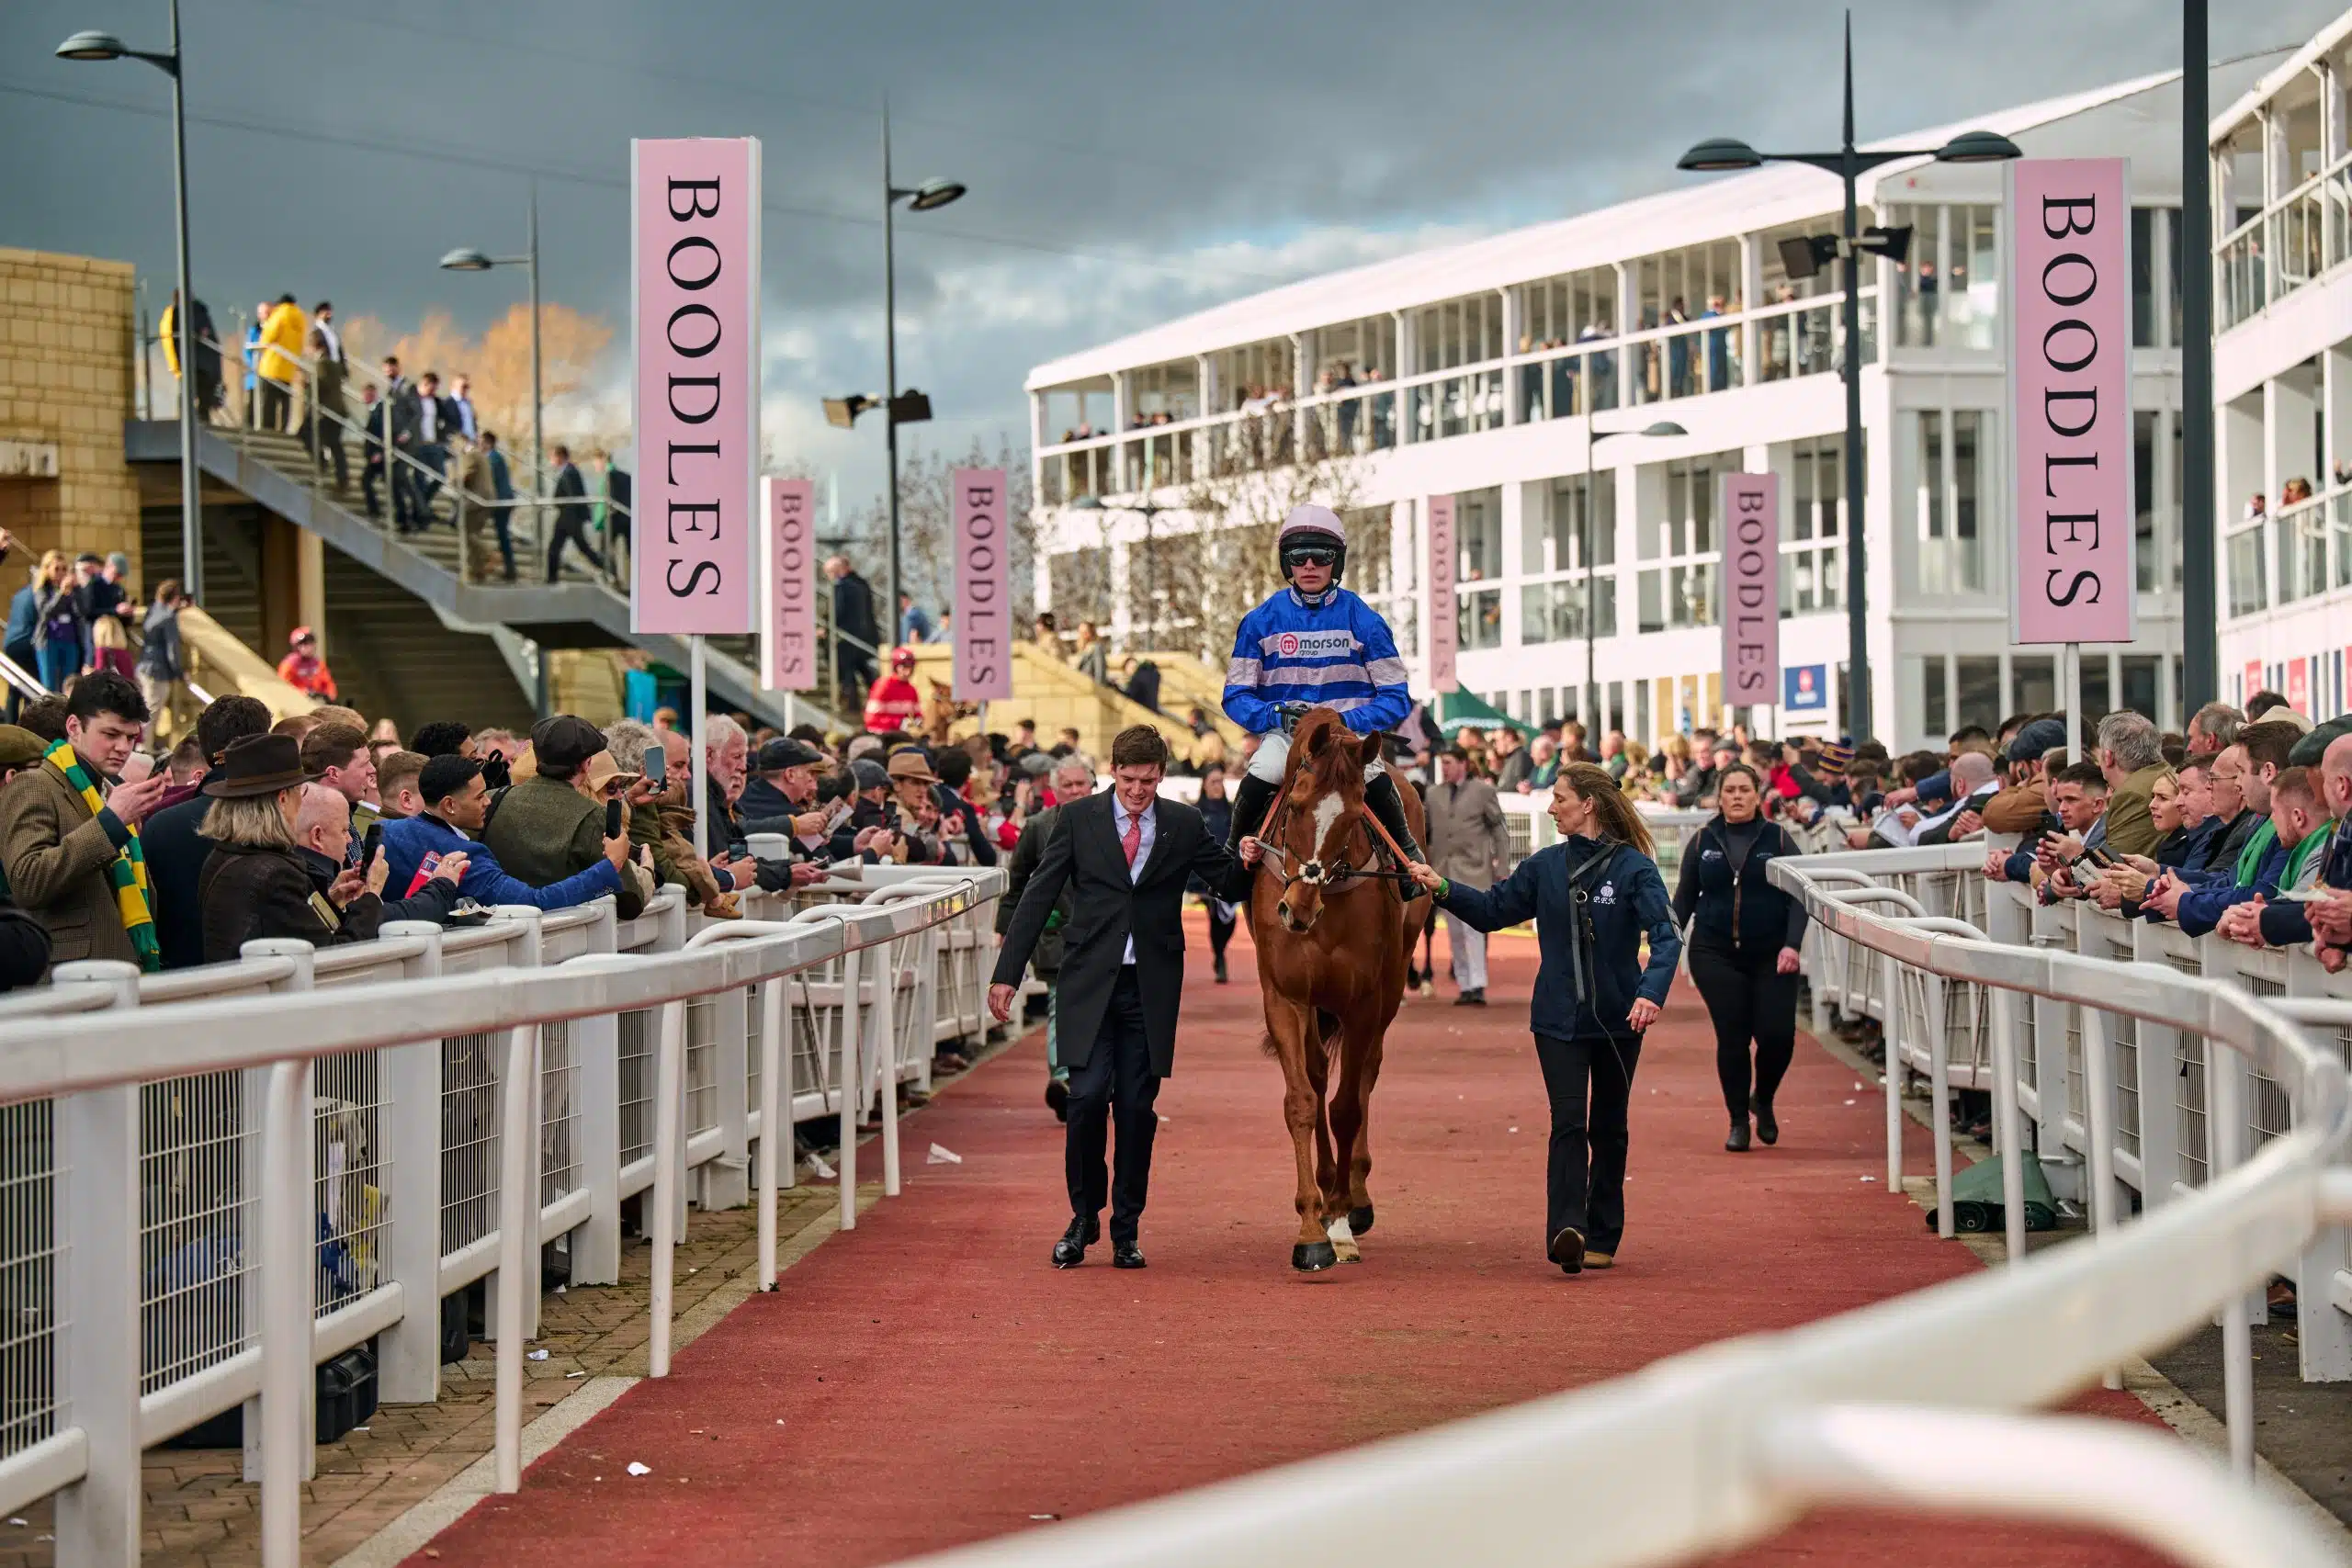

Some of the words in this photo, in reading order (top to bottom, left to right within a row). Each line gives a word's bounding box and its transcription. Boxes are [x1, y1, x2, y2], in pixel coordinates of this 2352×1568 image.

[666, 175, 722, 599] BOODLES
[2042, 193, 2101, 608] BOODLES
[781, 493, 803, 674] BOODLES
[967, 486, 997, 685] BOODLES
[1299, 637, 1350, 649] morson
[1737, 491, 1765, 692] BOODLES
